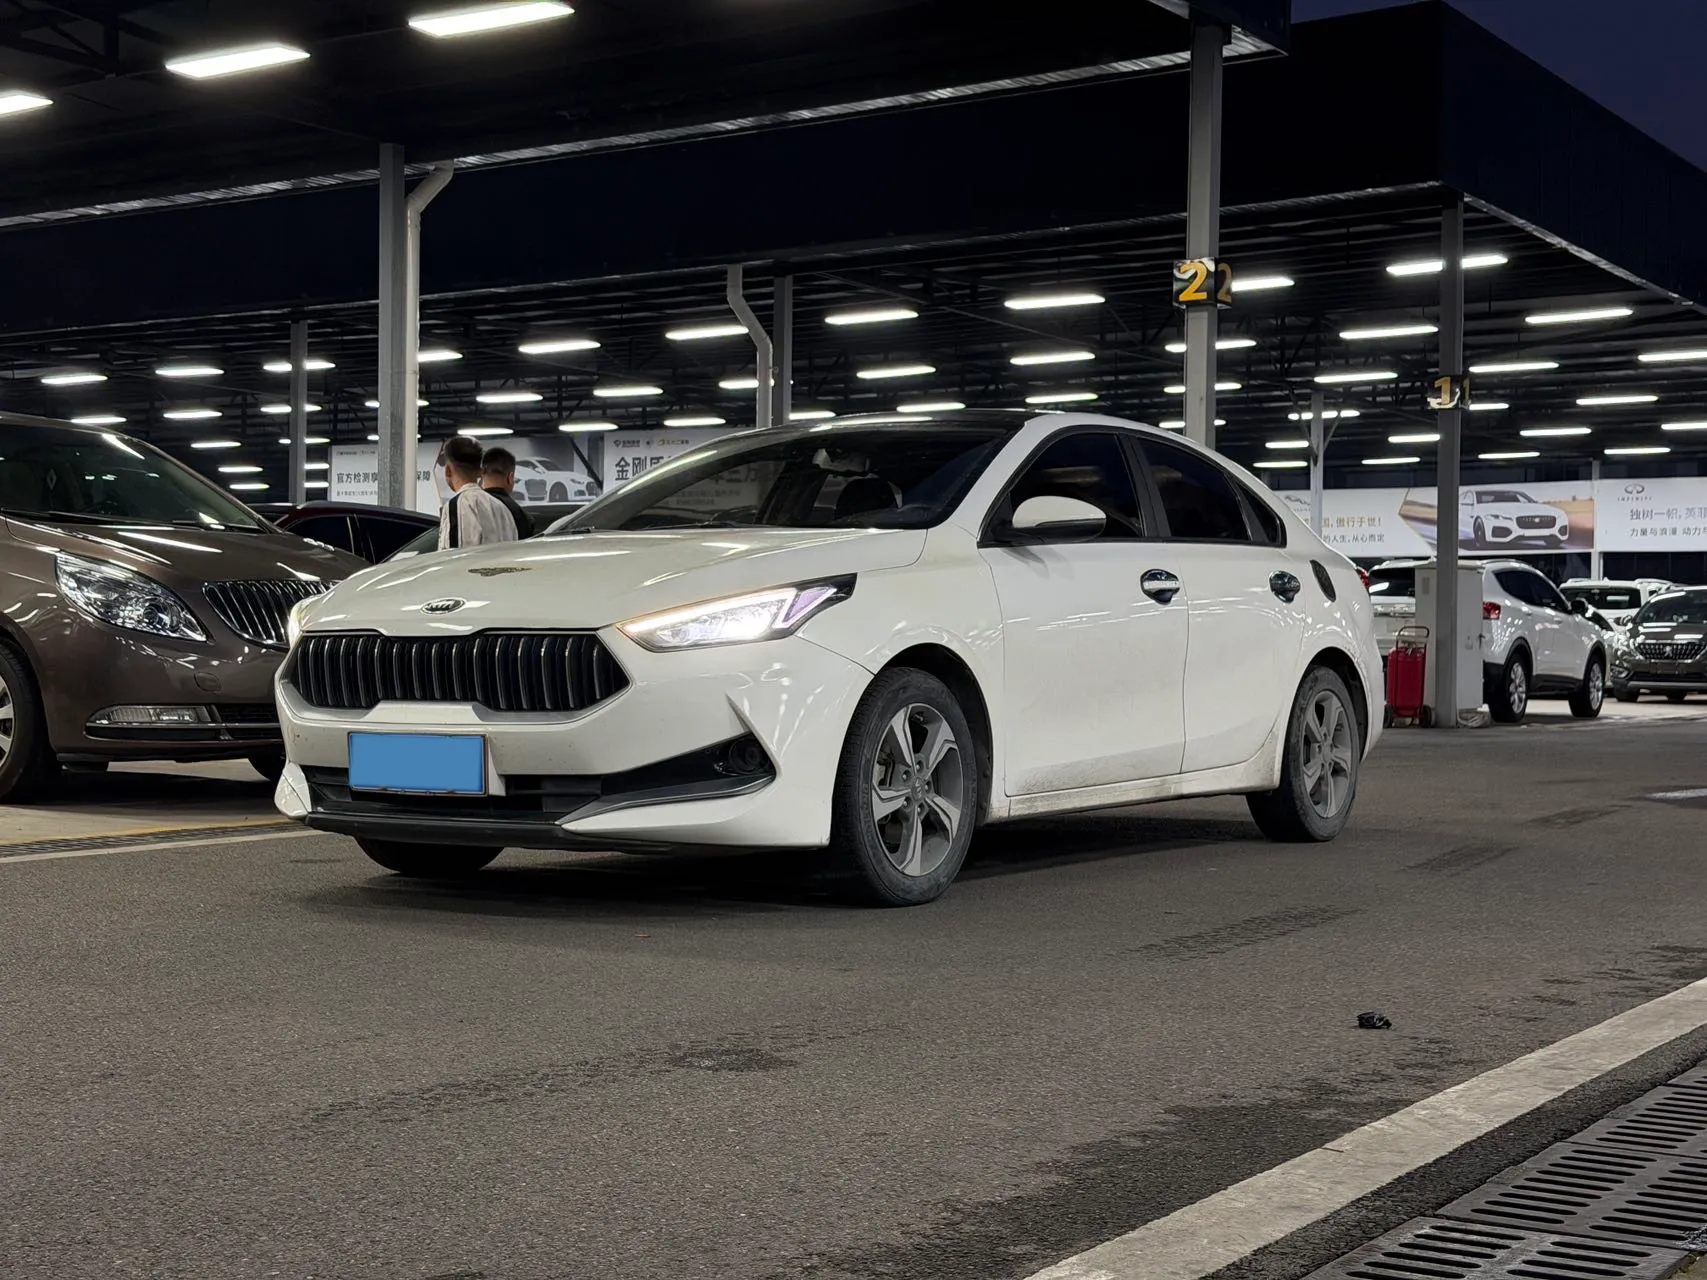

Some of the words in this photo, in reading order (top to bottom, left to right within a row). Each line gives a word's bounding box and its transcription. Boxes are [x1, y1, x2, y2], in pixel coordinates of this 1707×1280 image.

[1179, 261, 1208, 302] 2
[1217, 262, 1232, 303] 2
[1434, 376, 1451, 405] 1
